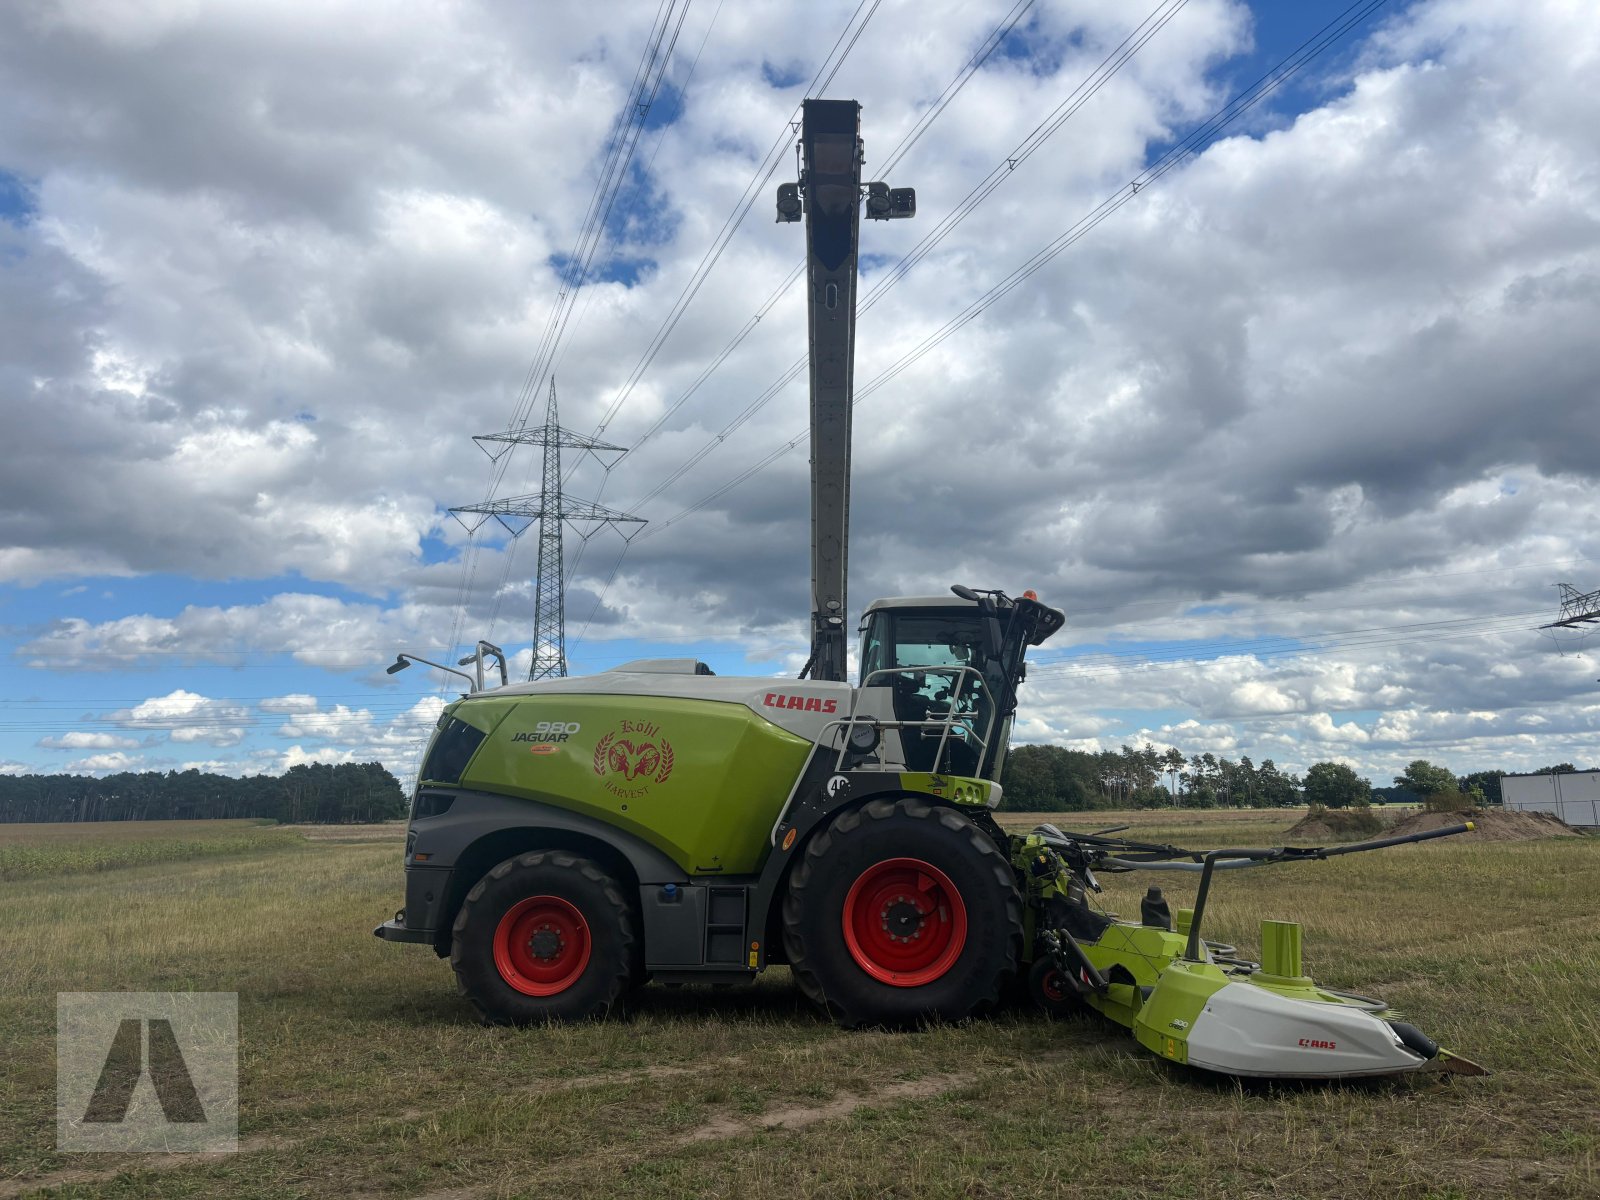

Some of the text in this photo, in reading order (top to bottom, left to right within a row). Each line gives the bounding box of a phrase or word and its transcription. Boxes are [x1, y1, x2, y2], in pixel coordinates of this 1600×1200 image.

[763, 693, 837, 713] CLAAS
[535, 722, 581, 734] 980
[620, 719, 660, 738] Köhl
[511, 732, 569, 742] JAGUAR
[605, 781, 649, 798] HARVEST
